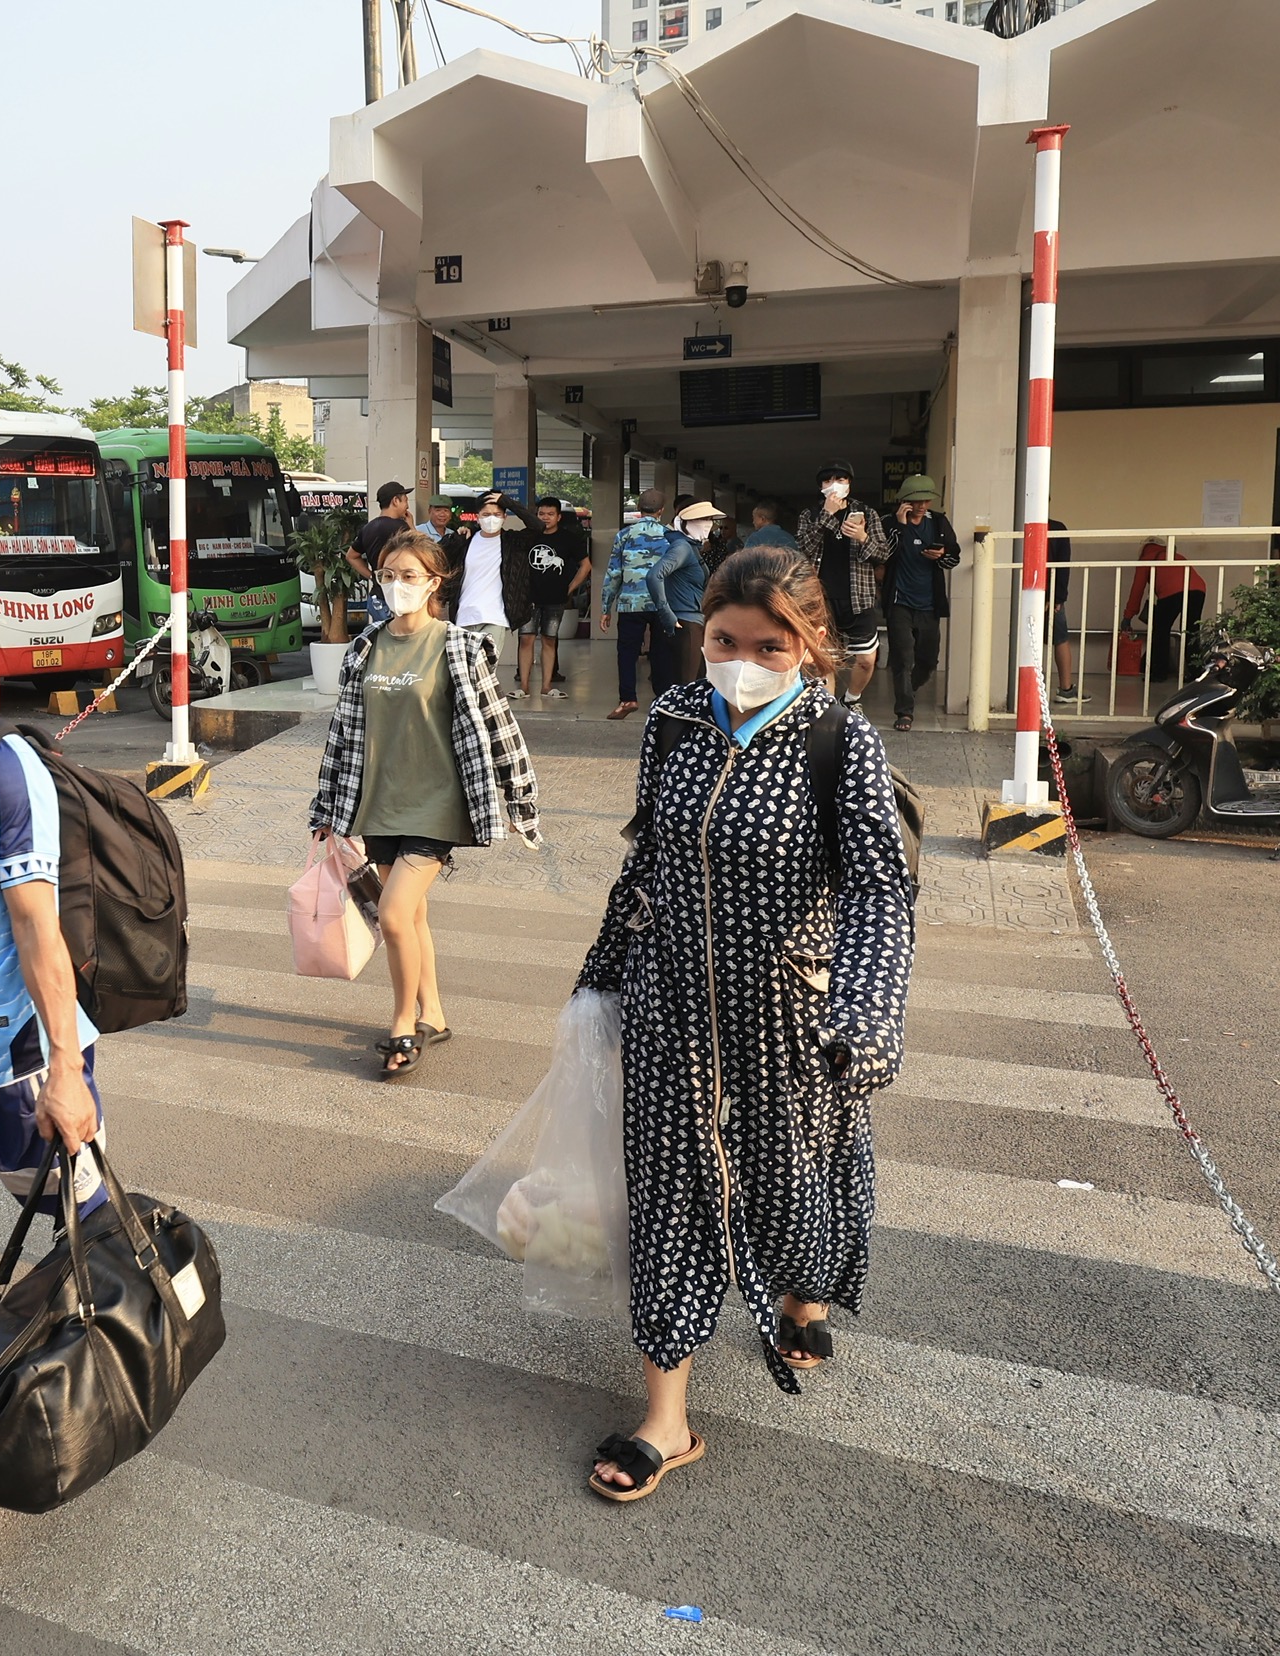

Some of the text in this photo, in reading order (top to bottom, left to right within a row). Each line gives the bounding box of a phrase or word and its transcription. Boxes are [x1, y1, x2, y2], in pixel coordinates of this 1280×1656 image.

[440, 265, 459, 281] 19
[493, 317, 508, 329] 18
[690, 344, 706, 353] WC
[569, 391, 582, 402] 17
[189, 461, 226, 480] ĐỊNH
[230, 457, 252, 477] HÀ
[52, 592, 95, 620] LONG
[202, 595, 235, 610] MINH
[30, 636, 65, 646] ISUZU
